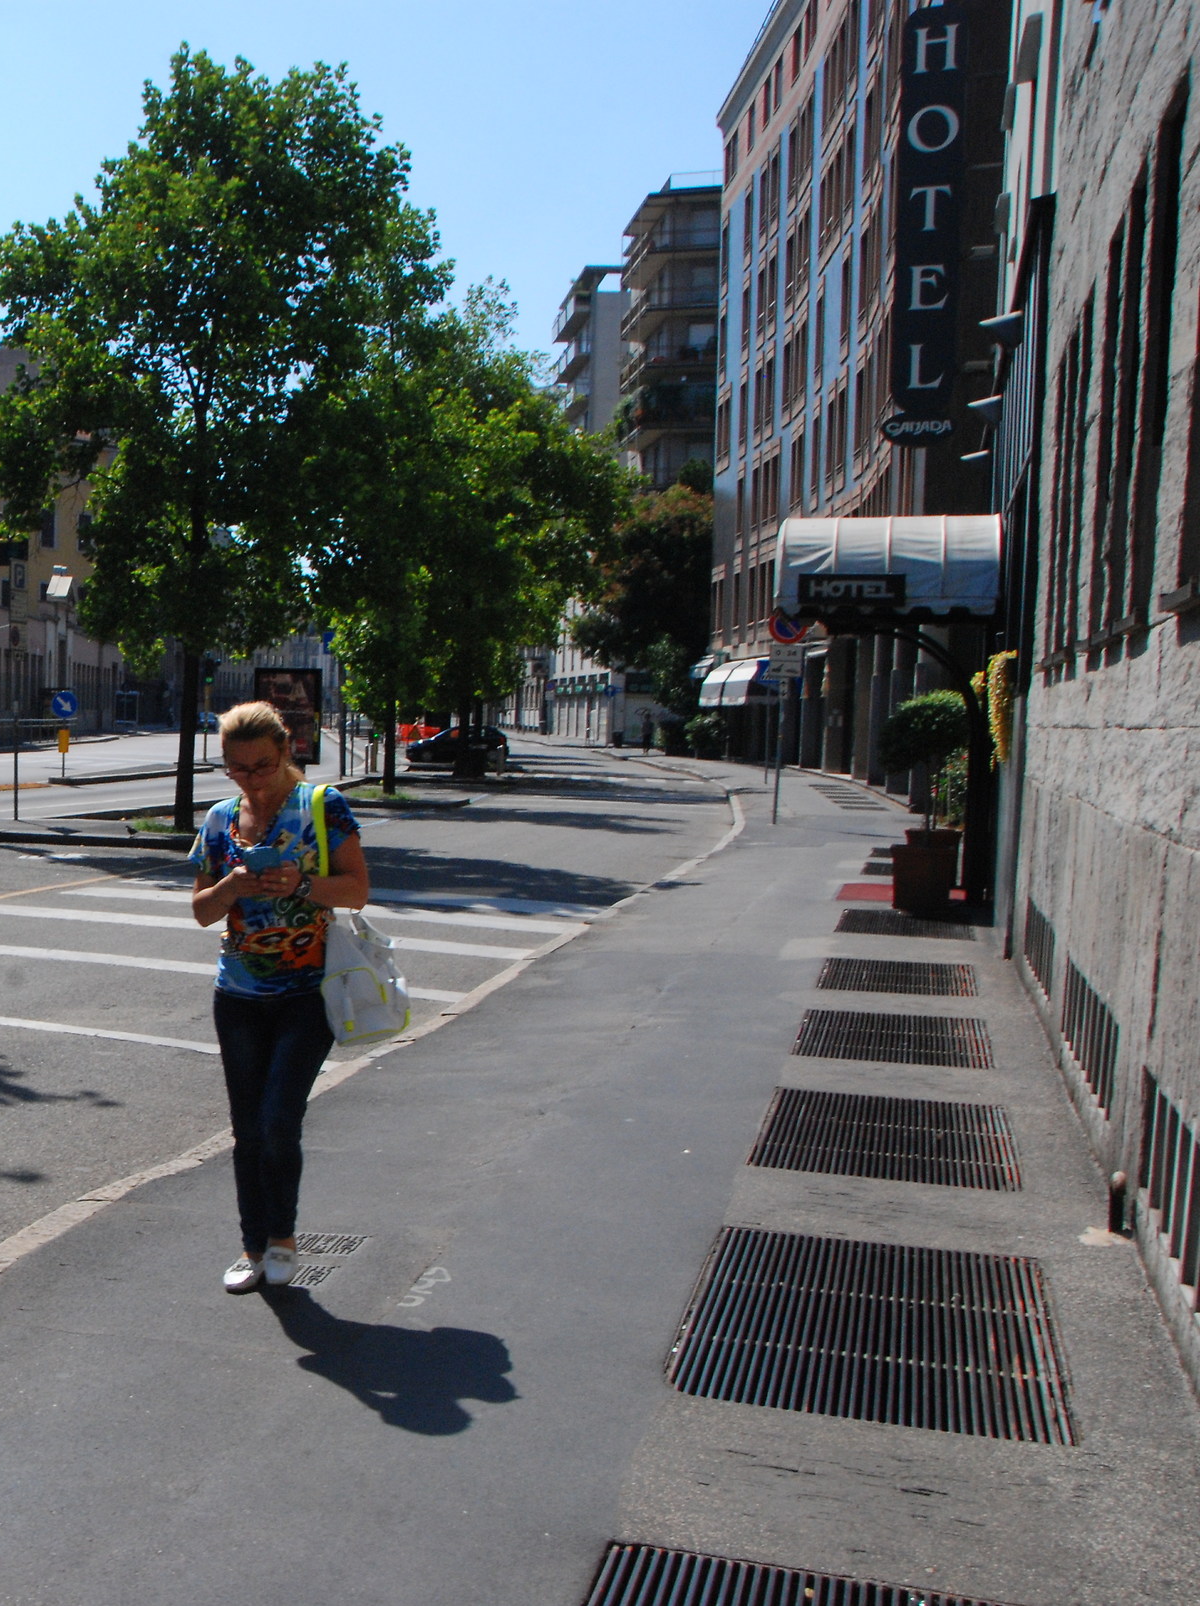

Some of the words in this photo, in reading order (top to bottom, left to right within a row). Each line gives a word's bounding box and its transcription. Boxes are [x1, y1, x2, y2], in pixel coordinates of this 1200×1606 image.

[907, 23, 961, 390] HOTEL
[885, 419, 953, 437] CANADA
[808, 579, 896, 598] HOTEL
